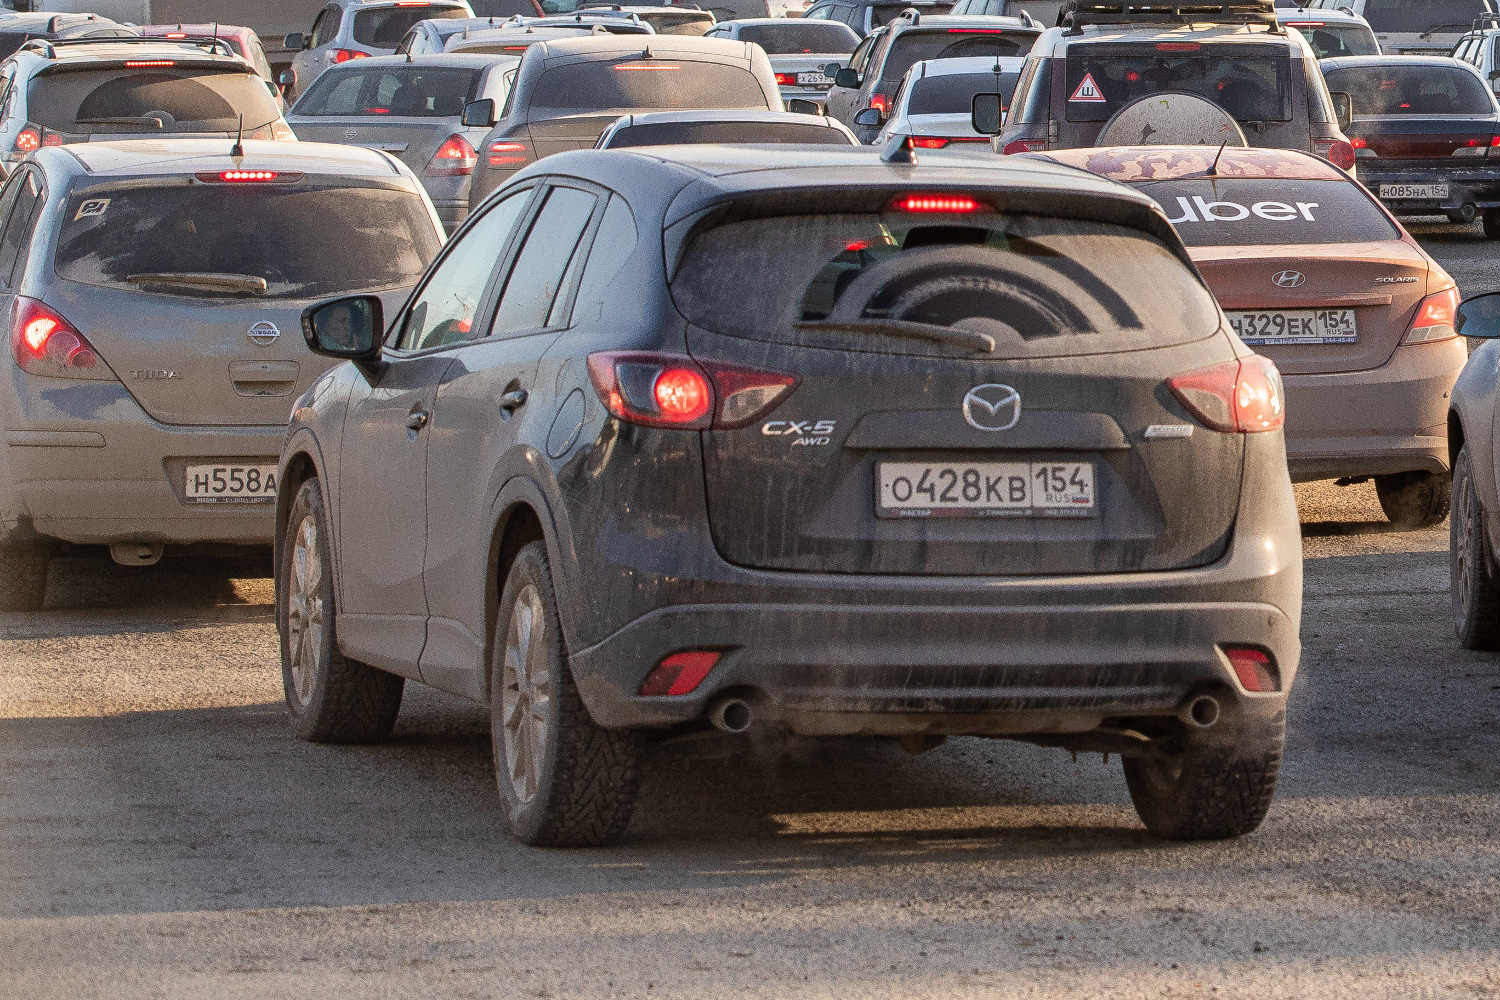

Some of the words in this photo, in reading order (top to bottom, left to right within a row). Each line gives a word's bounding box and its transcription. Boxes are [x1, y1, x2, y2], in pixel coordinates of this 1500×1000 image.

[1082, 86, 1093, 96] Ш
[1383, 185, 1427, 197] Н085НА
[1429, 185, 1447, 195] 154
[1318, 311, 1350, 329] 154
[761, 420, 837, 436] CX-5
[791, 436, 831, 446] AWD
[194, 468, 277, 494] Н558А
[892, 467, 1026, 503] О428КВ
[1035, 466, 1085, 494] 154
